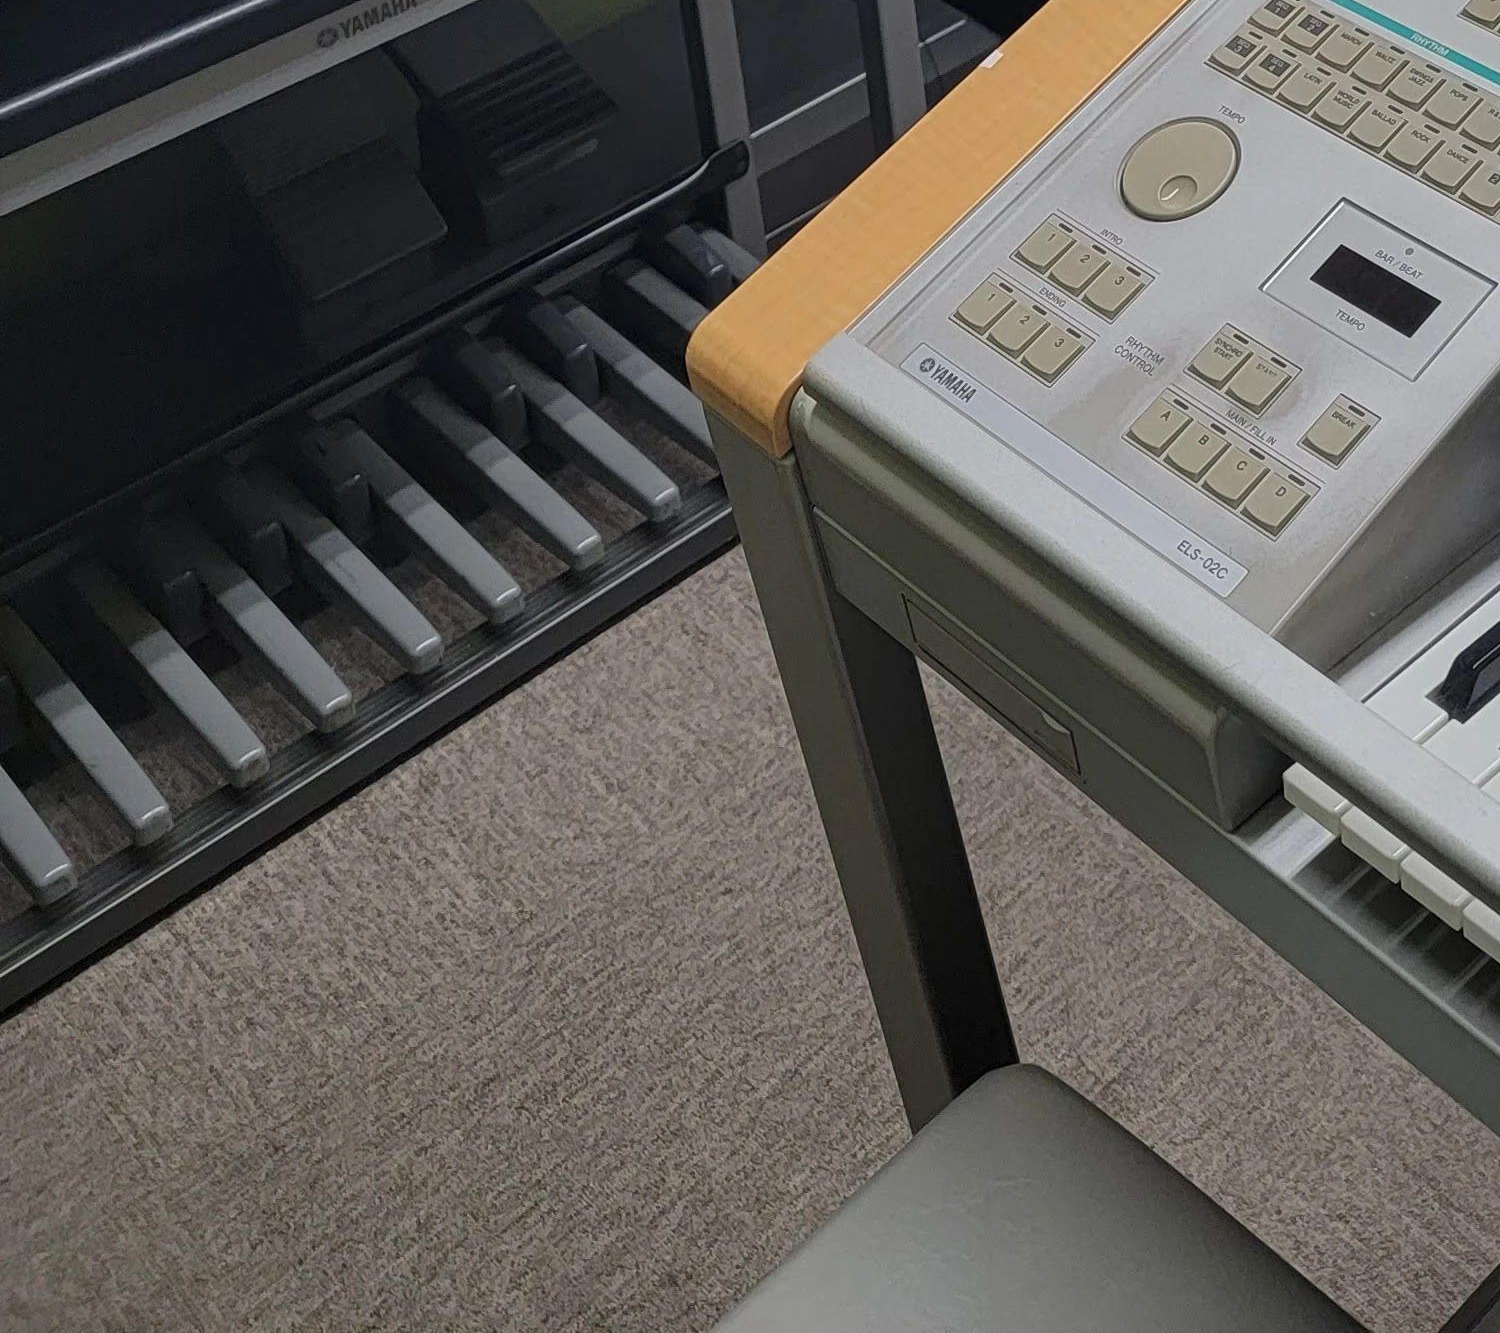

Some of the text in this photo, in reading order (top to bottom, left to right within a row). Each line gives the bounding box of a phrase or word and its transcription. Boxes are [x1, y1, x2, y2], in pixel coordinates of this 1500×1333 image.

[1306, 24, 1315, 32] 2
[1410, 33, 1450, 57] RHYTHM
[1303, 73, 1323, 85] LATIN
[1449, 88, 1469, 102] POPS
[1218, 105, 1246, 124] TEMPO
[1371, 109, 1397, 126] BALLAD
[1410, 130, 1432, 144] ROCK
[1446, 149, 1470, 164] DANCE
[1047, 233, 1057, 242] 1
[1100, 228, 1124, 246] INTRO
[1079, 254, 1091, 264] 2
[1374, 249, 1395, 264] BAR
[1398, 263, 1424, 281] BEAT
[1114, 276, 1125, 286] 3
[986, 293, 996, 302] 1
[1038, 286, 1067, 308] ENDING
[1019, 315, 1031, 325] 2
[1334, 309, 1366, 332] TEMPO
[1054, 338, 1065, 348] 3
[1214, 337, 1244, 358] SYNCHRO
[1124, 336, 1165, 366] RHYTHM
[1213, 346, 1234, 361] START
[1113, 345, 1155, 377] CONTROL
[929, 363, 977, 404] YAMAHA
[1160, 410, 1172, 422] A
[1331, 410, 1357, 430] BREAK
[1225, 409, 1246, 429] MAIN
[1250, 425, 1269, 441] FILL
[1265, 435, 1278, 447] IN
[1198, 434, 1210, 446] B
[1236, 460, 1248, 471] C
[1275, 486, 1287, 498] D
[1176, 538, 1229, 581] ELS-02C
